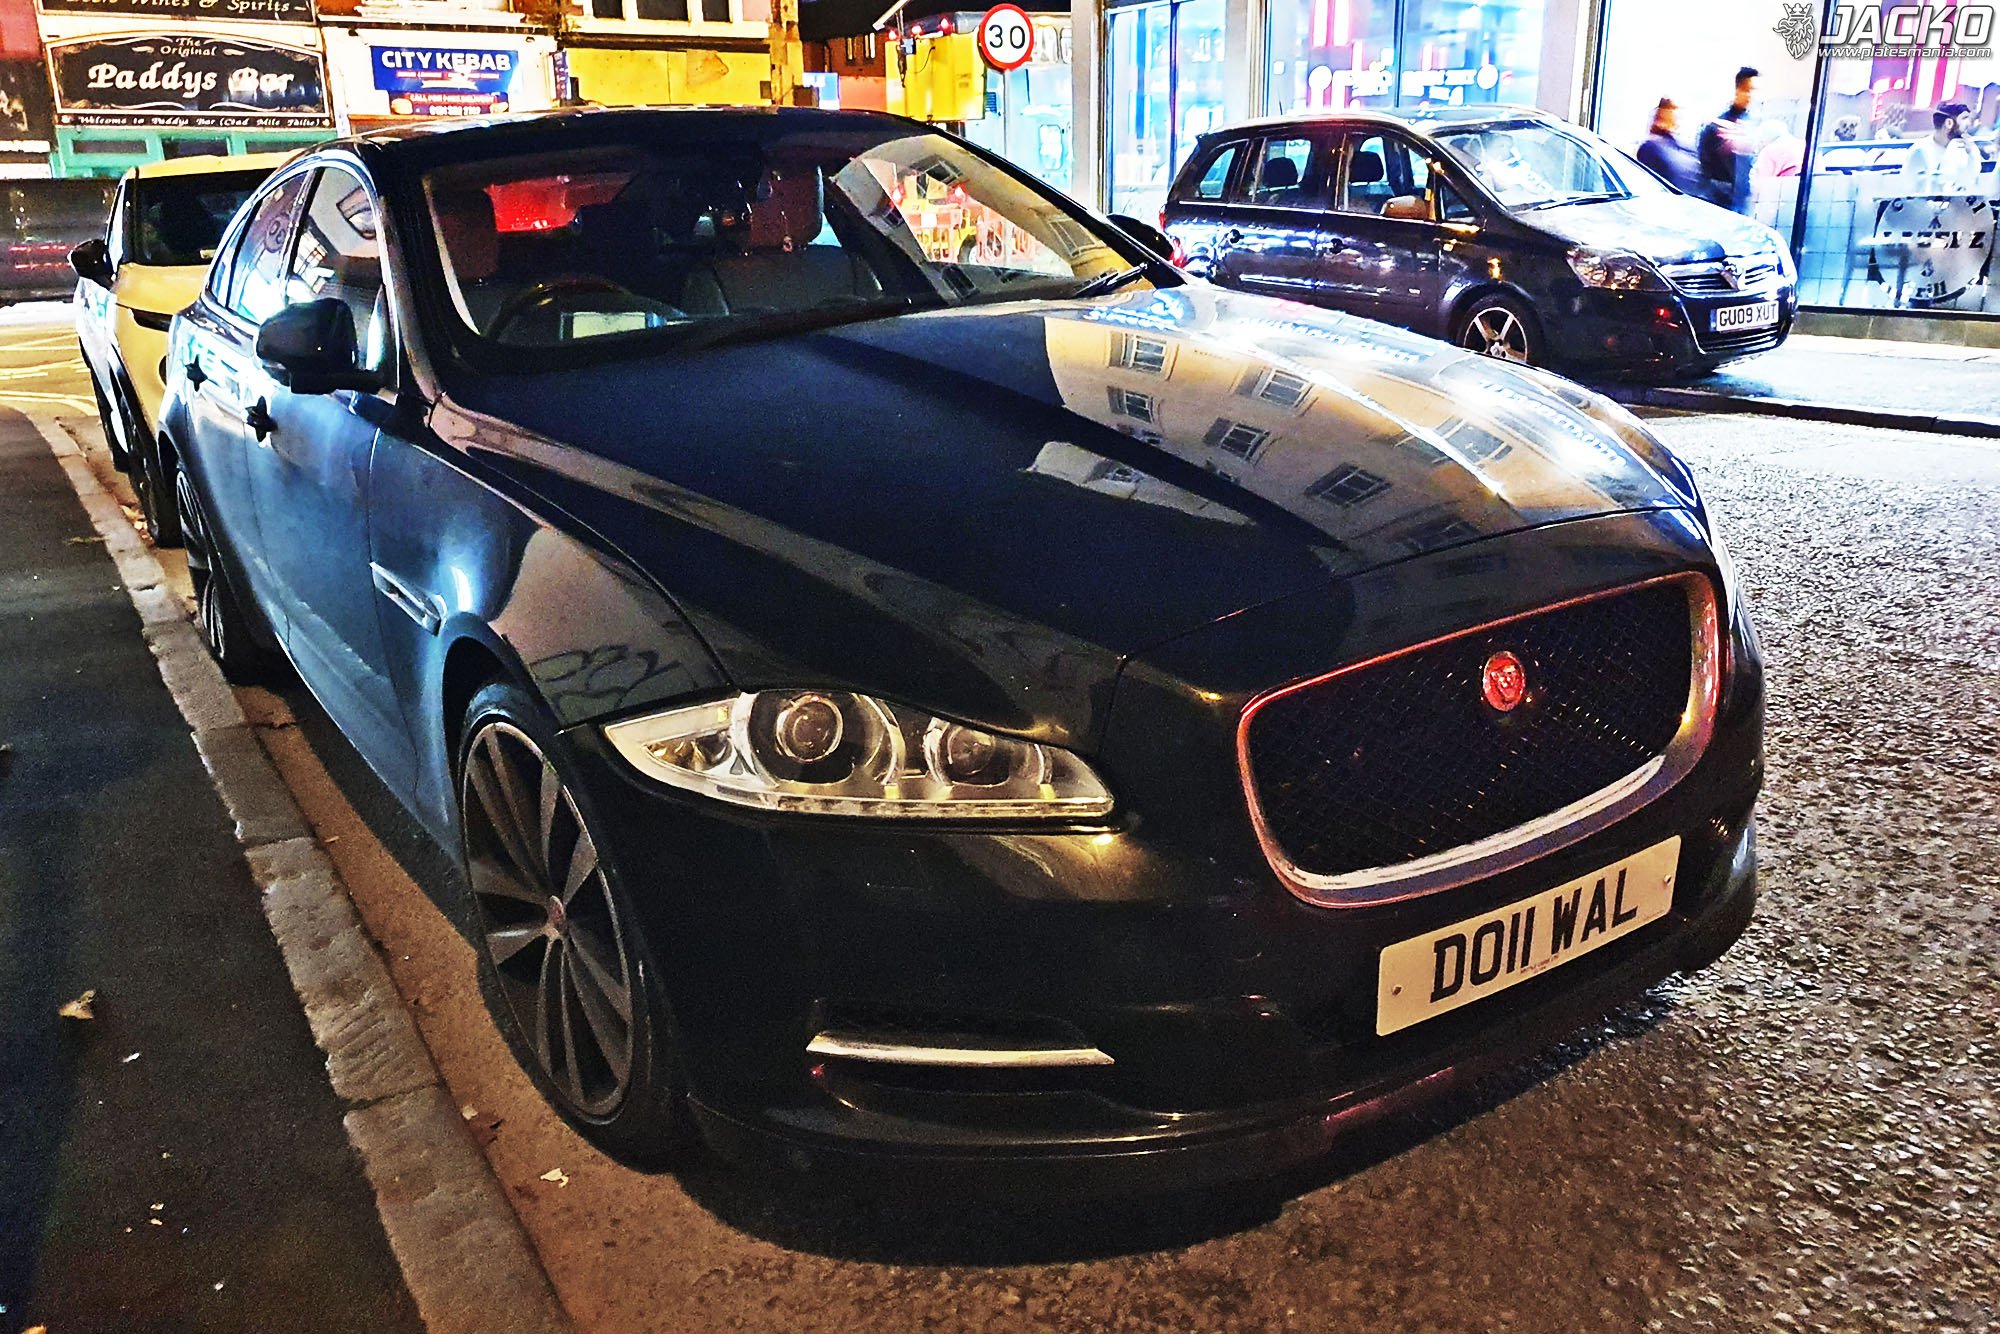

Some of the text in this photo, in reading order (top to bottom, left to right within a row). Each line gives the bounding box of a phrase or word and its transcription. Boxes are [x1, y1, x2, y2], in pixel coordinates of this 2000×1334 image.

[176, 37, 201, 47] The
[989, 24, 1026, 49] 30
[160, 45, 217, 57] Original
[381, 50, 511, 71] CITY KEBAB
[87, 61, 295, 99] Paddys Bar
[1719, 303, 1777, 327] GU09 XUT
[1551, 868, 1639, 955] WAL
